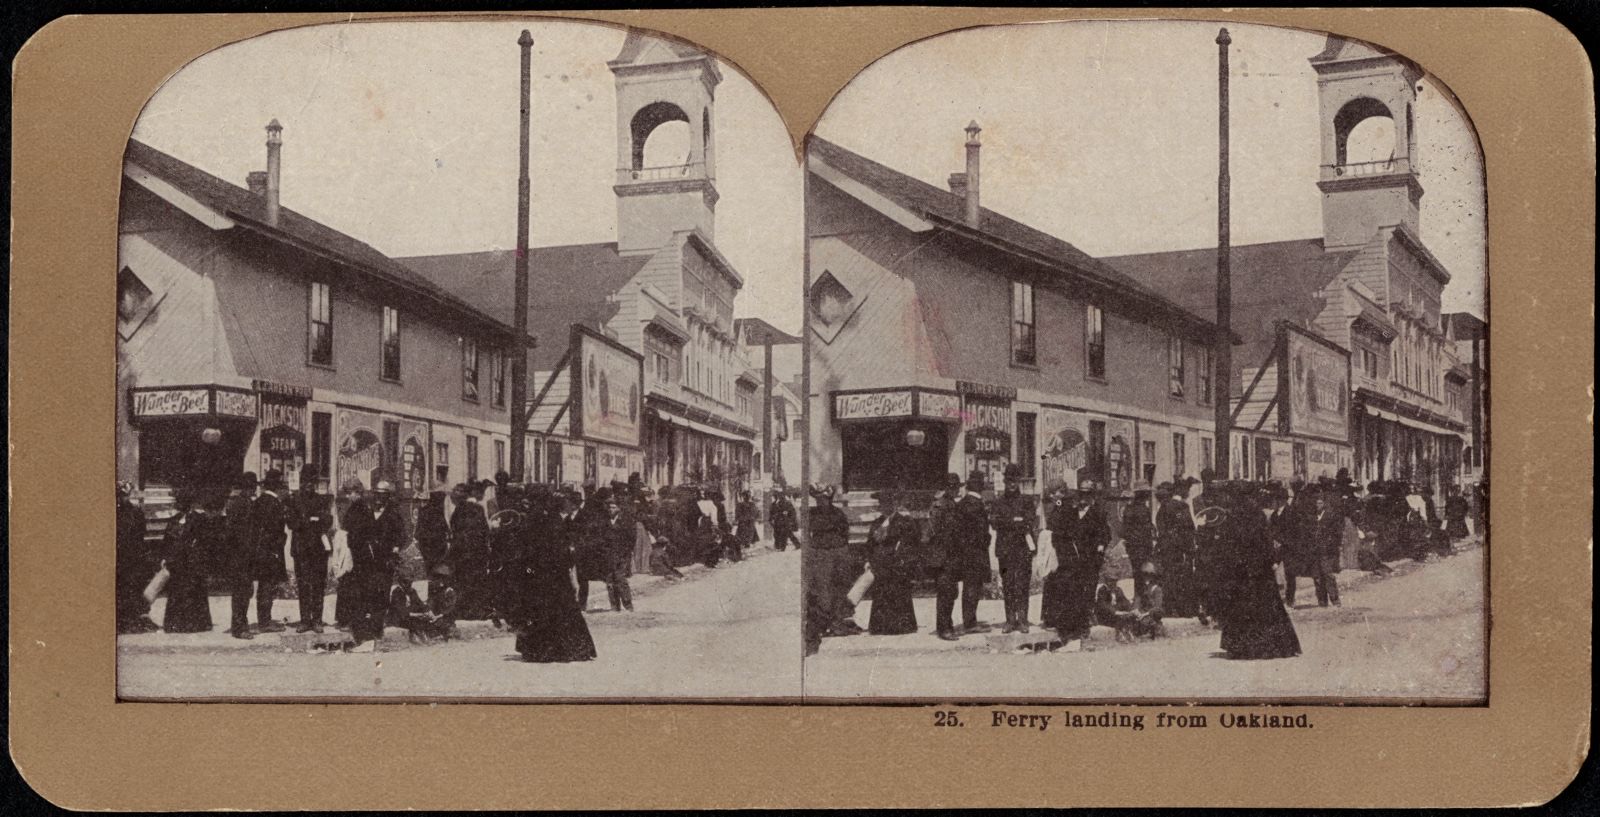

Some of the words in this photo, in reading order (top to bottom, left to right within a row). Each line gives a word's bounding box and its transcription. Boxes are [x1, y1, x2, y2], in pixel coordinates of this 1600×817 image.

[173, 393, 207, 414] Beer
[875, 395, 909, 416] Beer
[261, 402, 306, 433] JACKSON
[964, 403, 1011, 434] JACKSON
[270, 437, 296, 450] STEAM
[975, 437, 1001, 451] STEAM
